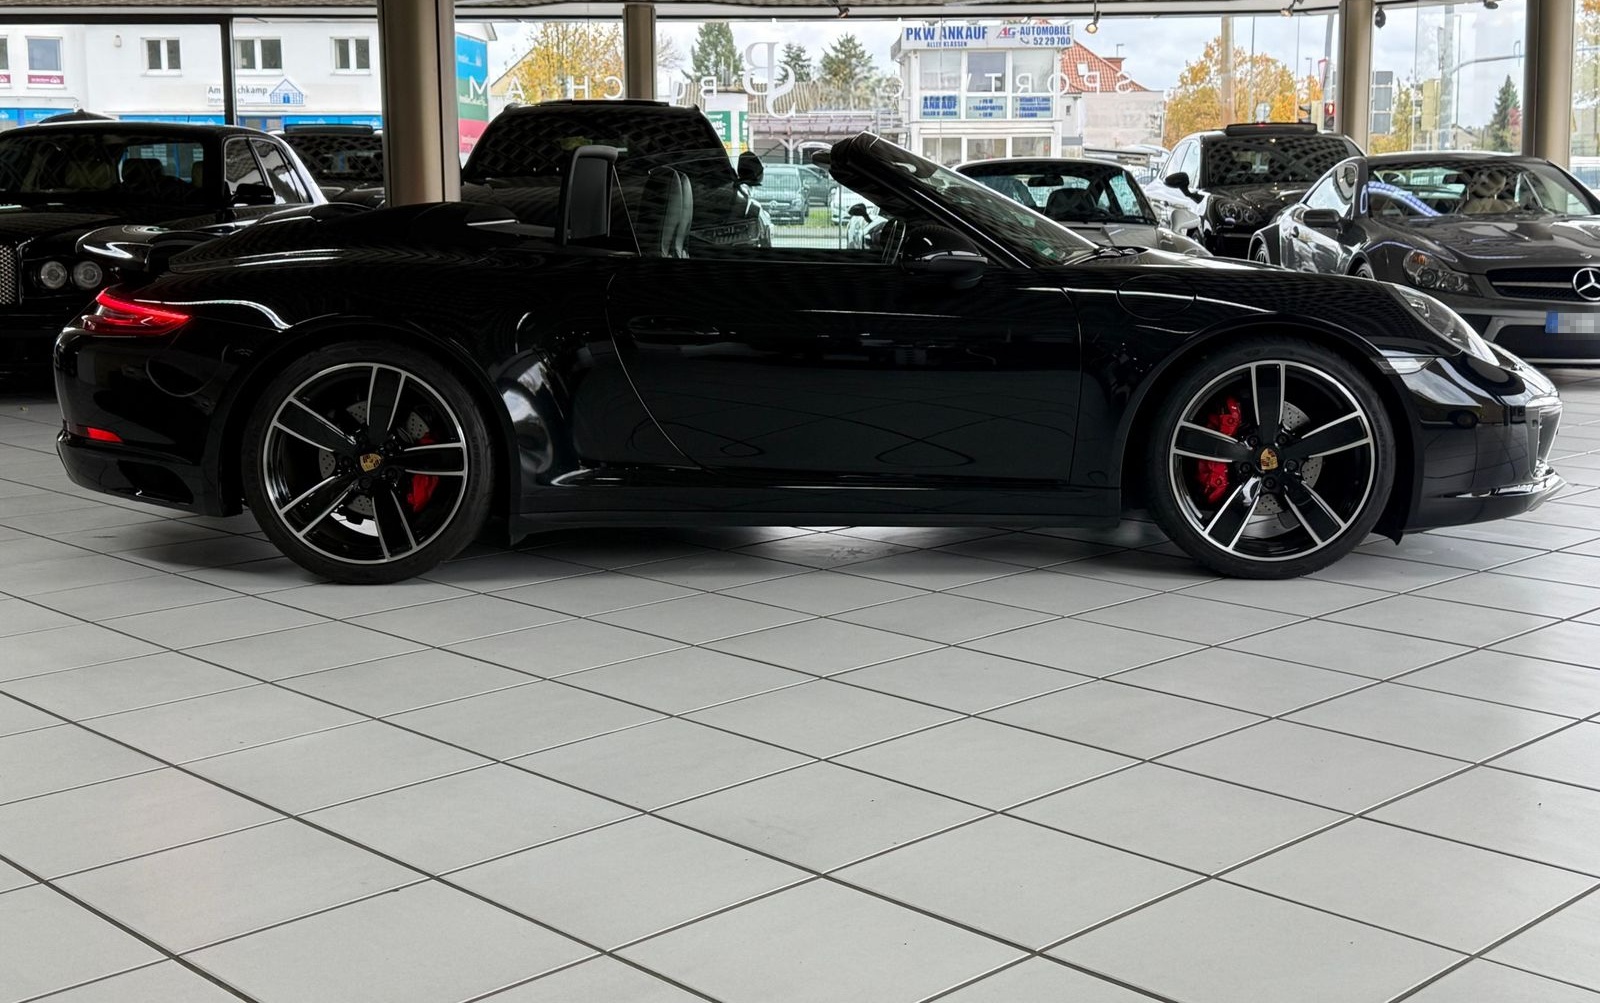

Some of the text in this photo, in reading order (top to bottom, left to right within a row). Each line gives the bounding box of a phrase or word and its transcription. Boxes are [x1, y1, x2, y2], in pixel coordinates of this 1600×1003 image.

[906, 26, 988, 41] PKW ANKAUF
[1033, 37, 1070, 45] 52 29 700
